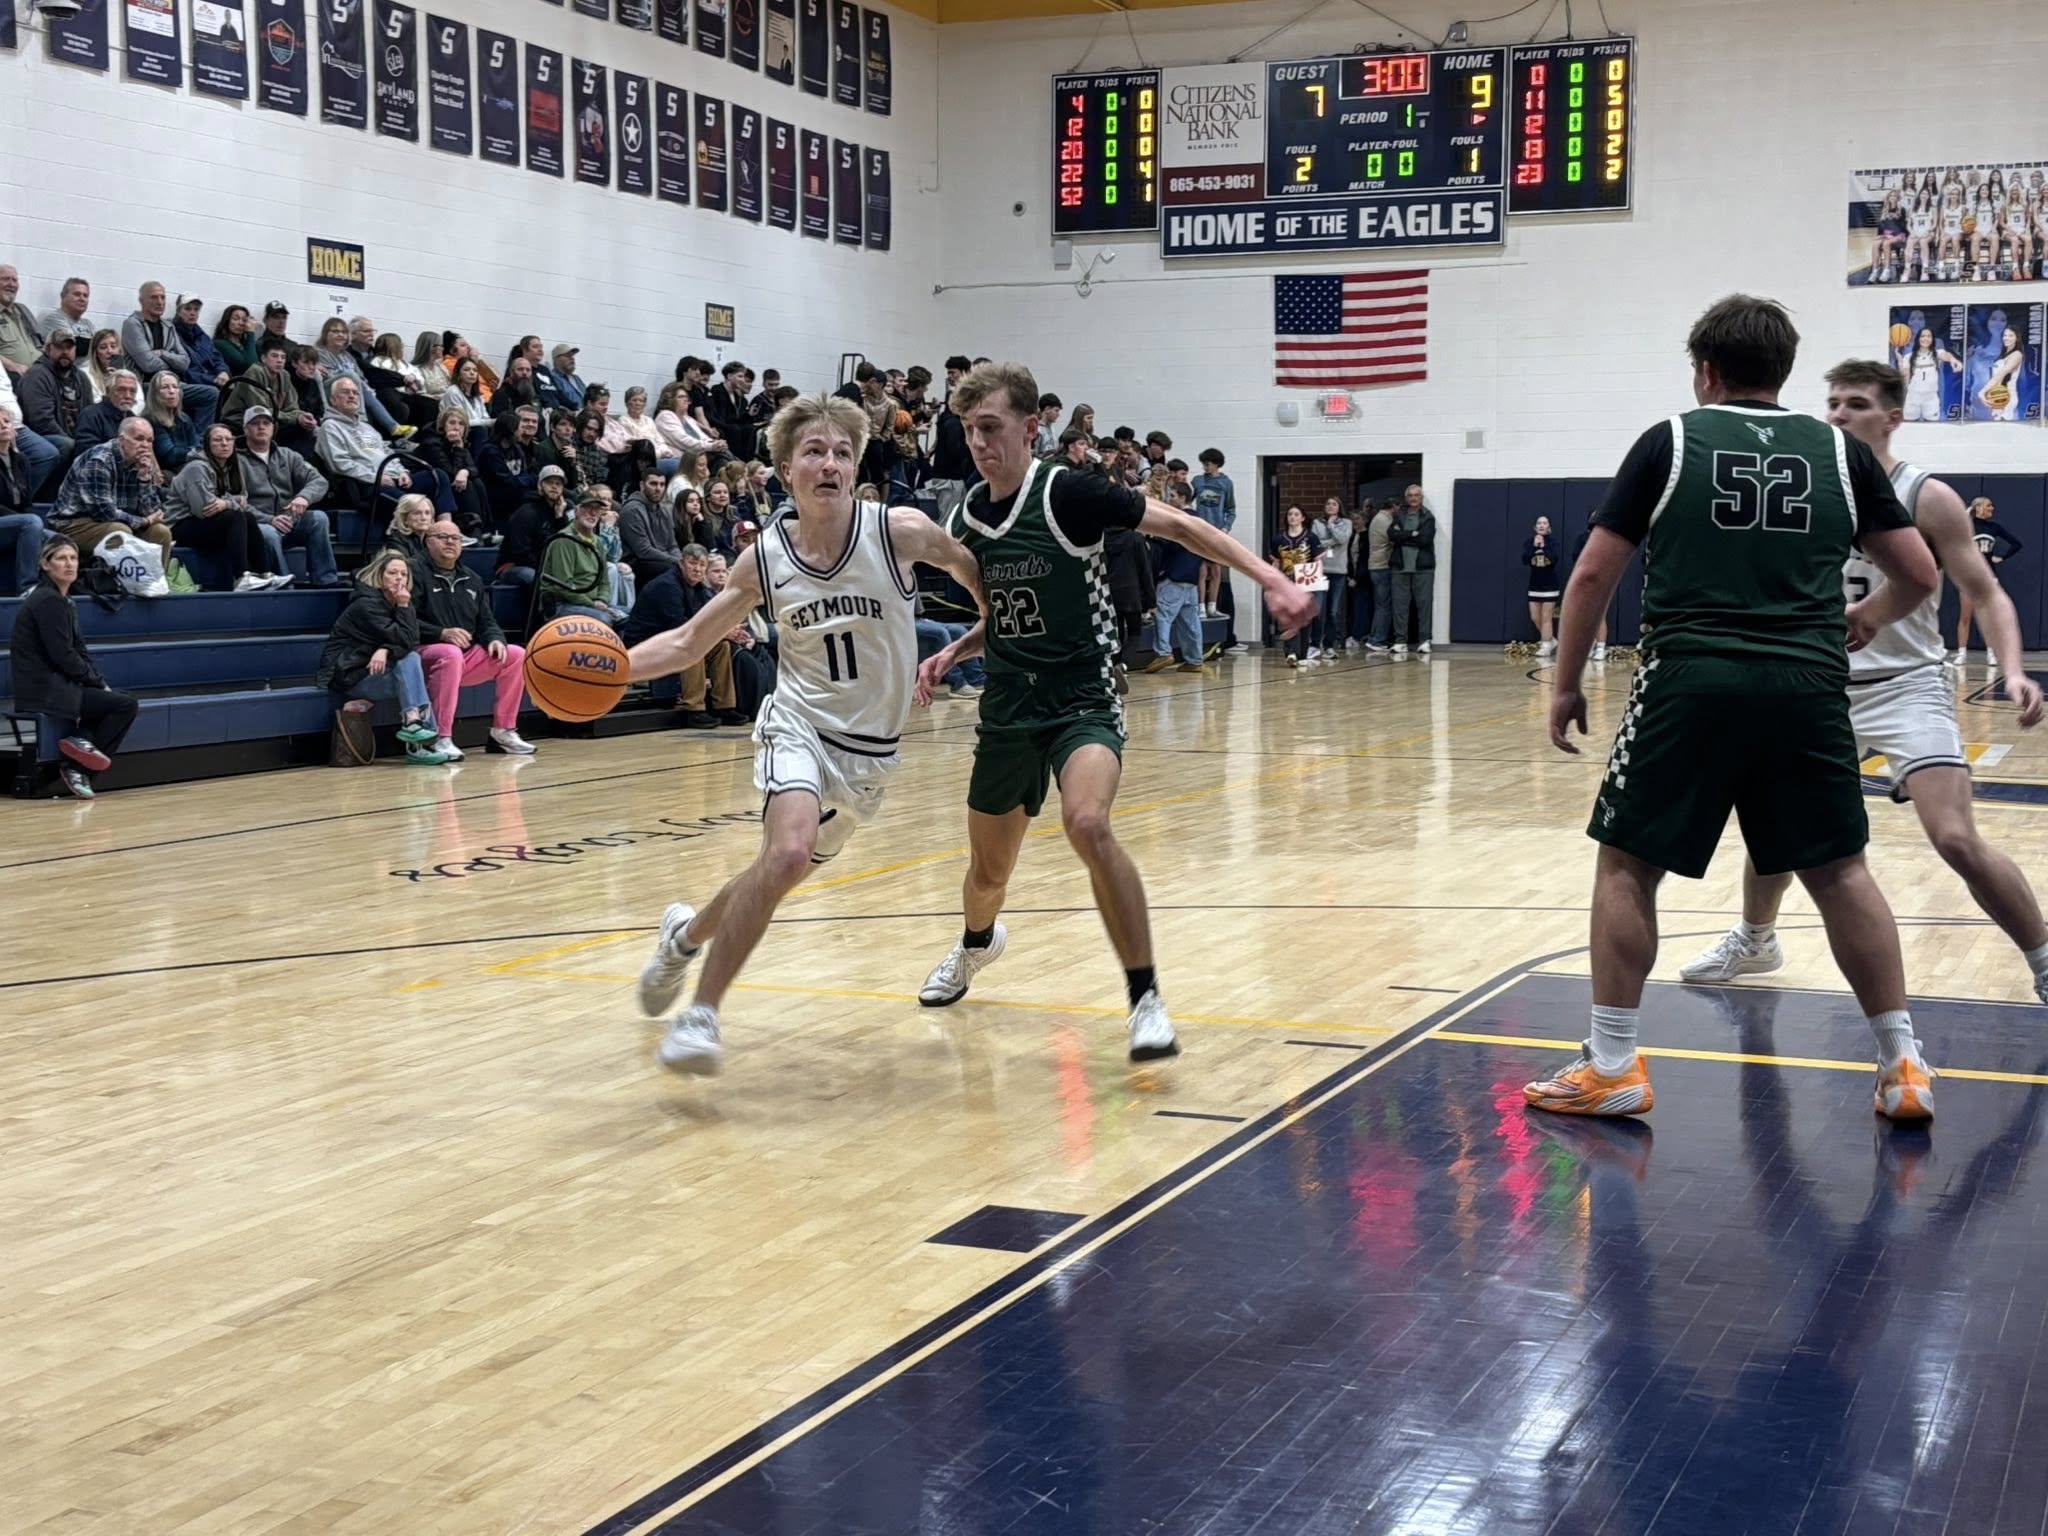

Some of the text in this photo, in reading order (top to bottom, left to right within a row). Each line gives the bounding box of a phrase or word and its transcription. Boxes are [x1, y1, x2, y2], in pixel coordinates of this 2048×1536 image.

[386, 9, 403, 38] S
[440, 26, 456, 54] S
[1444, 54, 1494, 70] HOME
[1514, 50, 1550, 60] PLAYER
[1275, 65, 1328, 80] GUEST
[1362, 57, 1426, 94] 3:00
[1531, 60, 1623, 86] 0 0 0
[1056, 80, 1088, 90] PLAYER
[1170, 83, 1256, 105] CITIZENS
[1471, 74, 1491, 108] 9
[1106, 92, 1118, 110] 0
[1140, 90, 1152, 110] 0
[1305, 86, 1324, 117] 7
[1525, 84, 1623, 110] 11 0 5
[1106, 116, 1117, 134] 0
[1140, 113, 1152, 132] 0
[1165, 102, 1262, 124] NATIONAL
[1340, 111, 1388, 124] PERIOD
[1406, 103, 1412, 128] 1
[1568, 112, 1582, 132] 0
[1607, 109, 1622, 130] 0
[1188, 120, 1240, 141] BANK
[1450, 136, 1484, 146] FOULS
[1106, 140, 1116, 158] 0
[1140, 136, 1152, 156] 0
[1285, 145, 1317, 154] FOULS
[1568, 137, 1581, 156] 0
[1606, 134, 1622, 156] 2
[1296, 157, 1312, 182] 2
[1367, 151, 1414, 178] 0 0
[1471, 148, 1479, 173] 1
[1517, 158, 1622, 184] 23 0 2
[1061, 164, 1083, 183] 22
[1106, 162, 1116, 180] 0
[1169, 174, 1256, 192] 865-453-9031
[1447, 176, 1486, 186] POINTS
[1106, 185, 1116, 204] 0
[1146, 183, 1152, 202] 1
[1282, 183, 1319, 194] POINTS
[1348, 180, 1386, 190] MATCH
[1170, 201, 1494, 248] HOME OF THE EAGLES
[310, 244, 362, 282] HOME
[708, 306, 732, 327] HOME
[1711, 450, 1812, 533] 52
[790, 596, 884, 631] SEYMOUR
[990, 587, 1047, 638] 22
[568, 652, 617, 673] NCAA
[824, 632, 858, 682] 11
